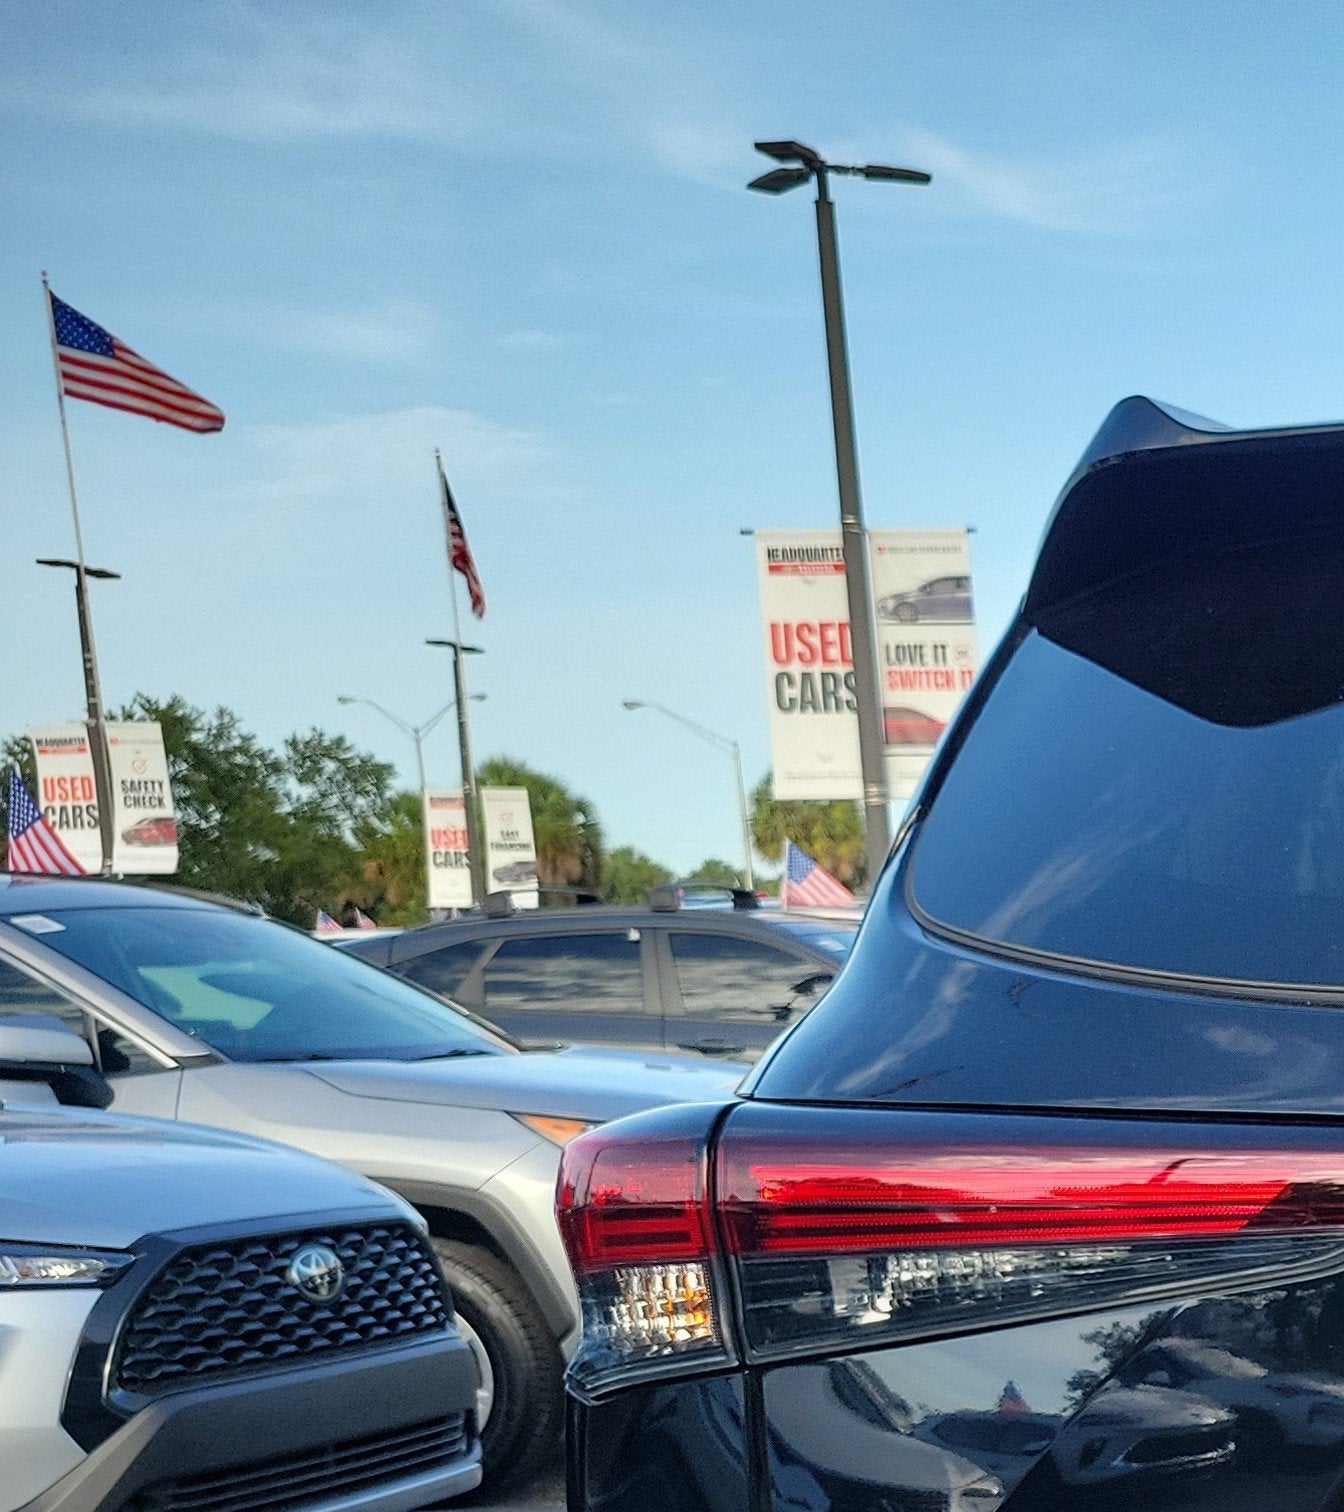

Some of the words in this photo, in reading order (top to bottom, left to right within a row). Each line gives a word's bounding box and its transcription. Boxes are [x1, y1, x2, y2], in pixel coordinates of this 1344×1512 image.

[766, 547, 844, 562] HEADQUARTE
[886, 643, 926, 667] LOVE
[933, 643, 948, 666] IT
[888, 669, 954, 691] SWITCH
[43, 775, 94, 803] USED
[121, 779, 164, 794] SAFETY
[123, 795, 166, 809] CHECK
[44, 804, 98, 830] CARS
